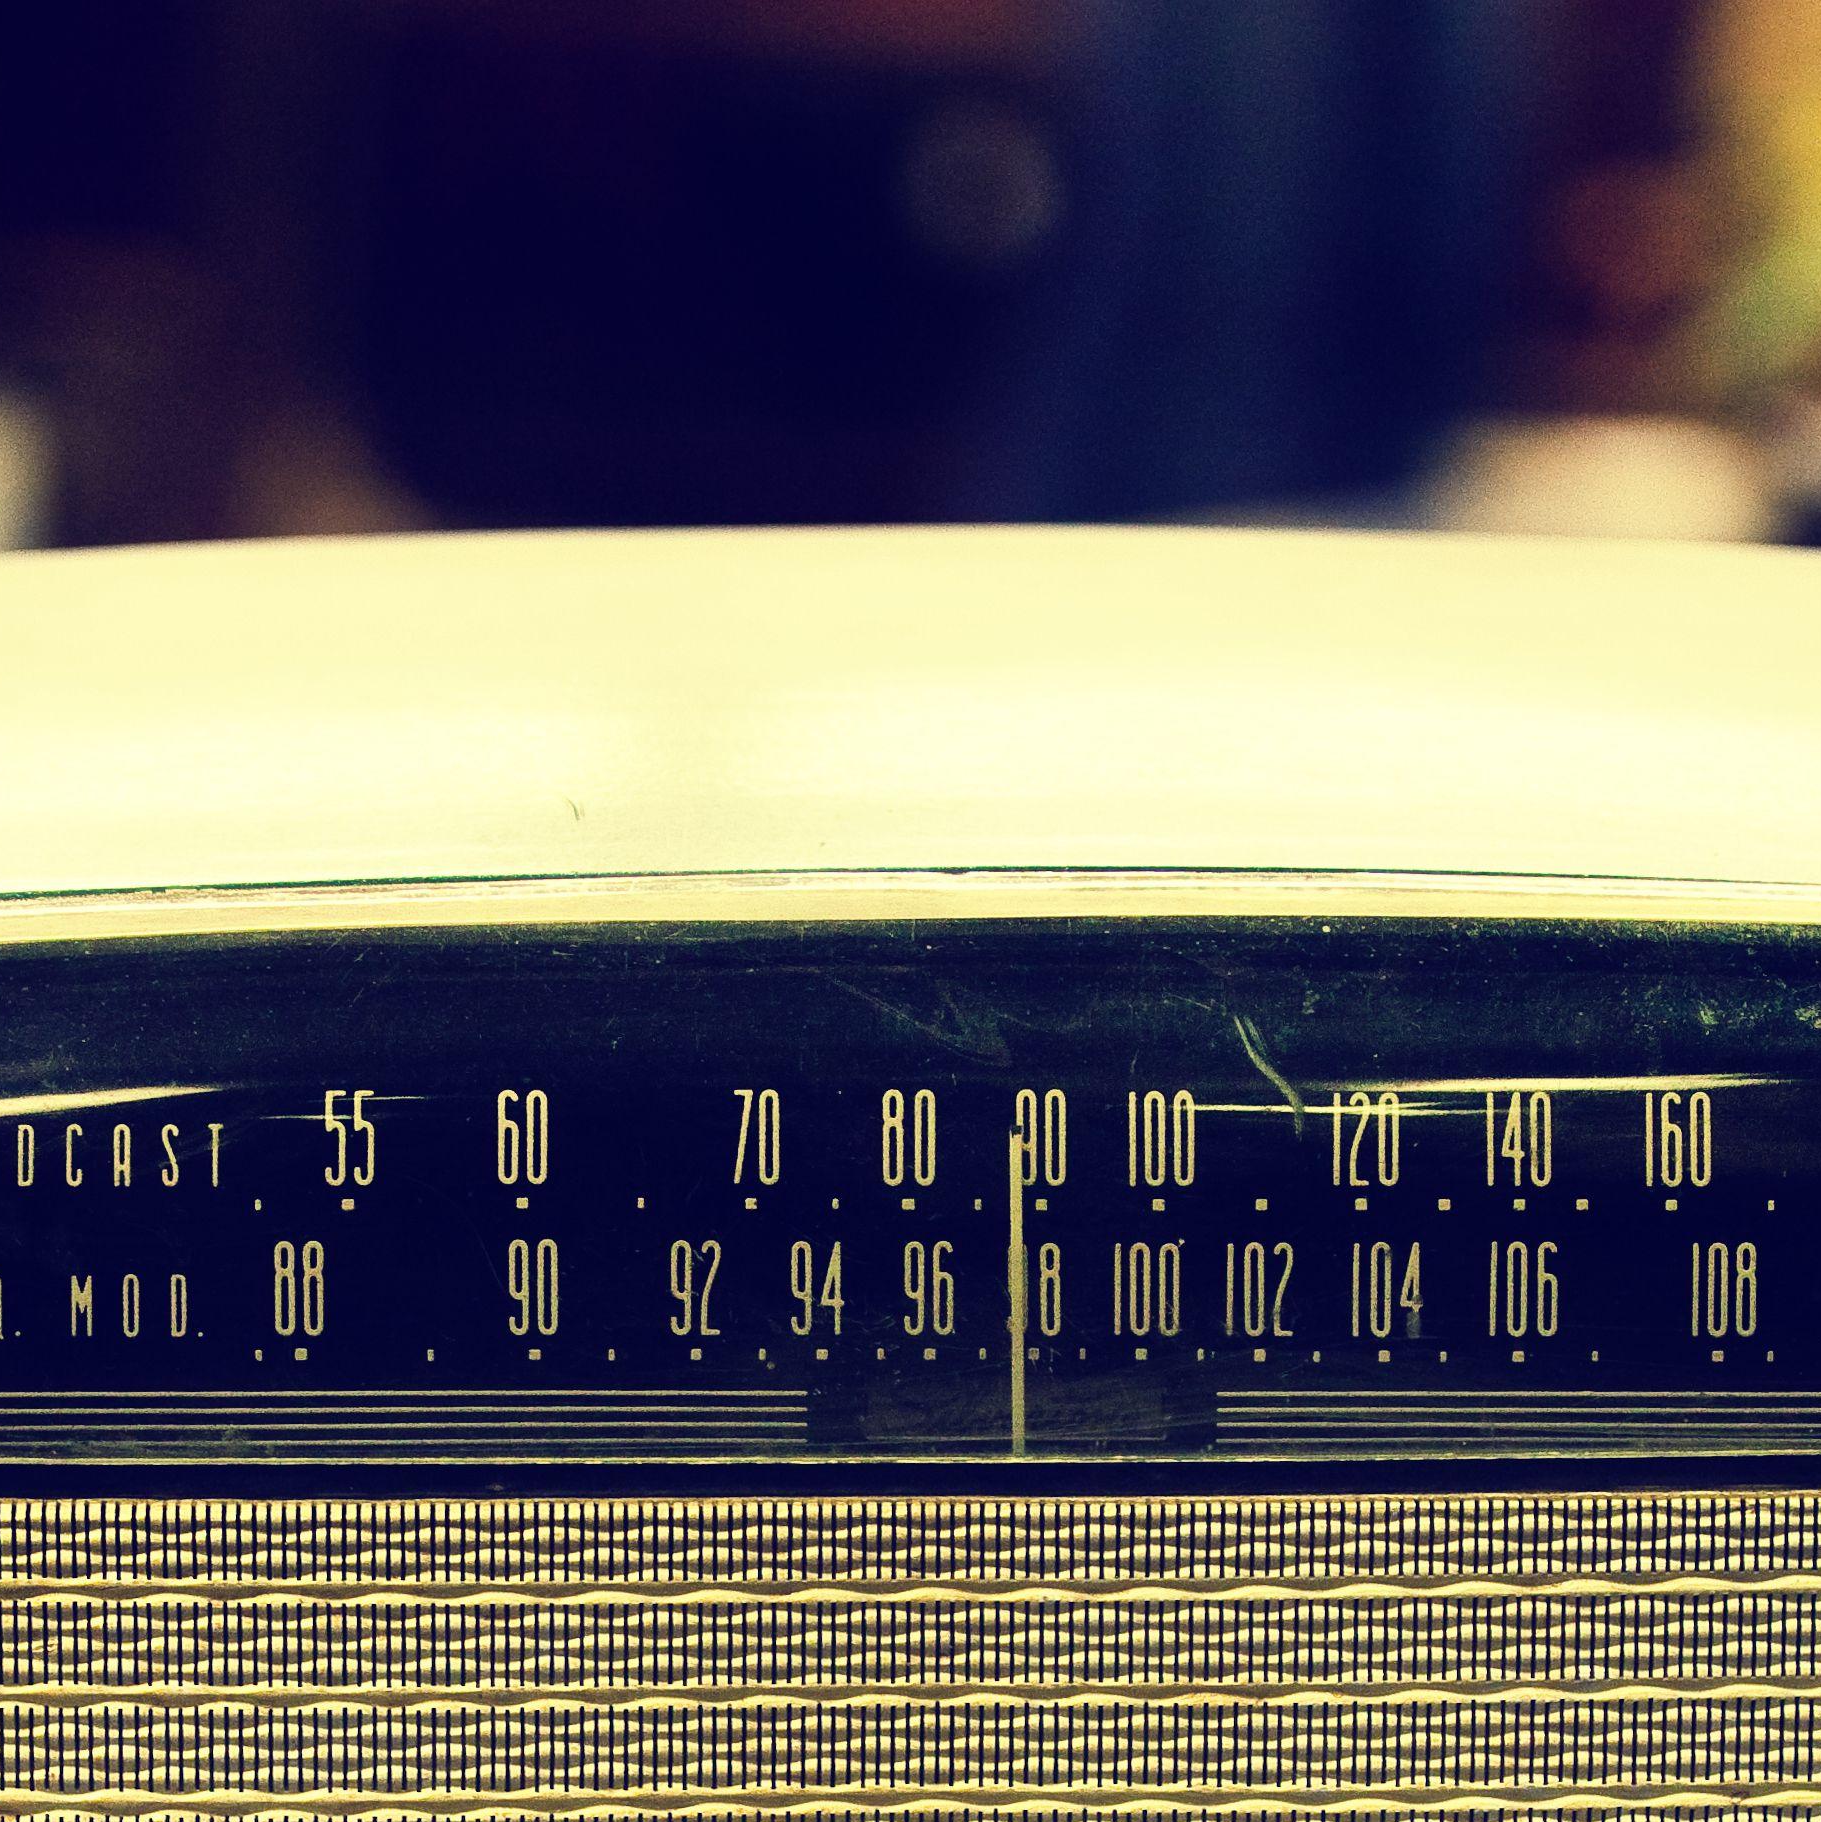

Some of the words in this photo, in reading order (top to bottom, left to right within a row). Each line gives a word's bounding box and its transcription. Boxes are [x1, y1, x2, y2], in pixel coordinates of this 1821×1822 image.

[325, 1090, 375, 1187] 55
[497, 1090, 549, 1186] 60
[733, 1089, 780, 1186] 70
[882, 1089, 937, 1187] 80
[1128, 1090, 1195, 1187] 100
[1332, 1091, 1400, 1187] 120
[1486, 1091, 1553, 1187] 140
[1646, 1091, 1713, 1188] 160
[70, 1273, 206, 1339] MOD.
[274, 1240, 325, 1337] 88
[508, 1239, 559, 1336] 90
[670, 1240, 722, 1336] 92
[790, 1241, 846, 1336] 94
[904, 1241, 956, 1336] 96
[1114, 1243, 1181, 1337] 100
[1226, 1242, 1294, 1337] 102
[1352, 1242, 1424, 1338] 104
[1490, 1242, 1559, 1338] 106
[1692, 1242, 1757, 1338] 108
